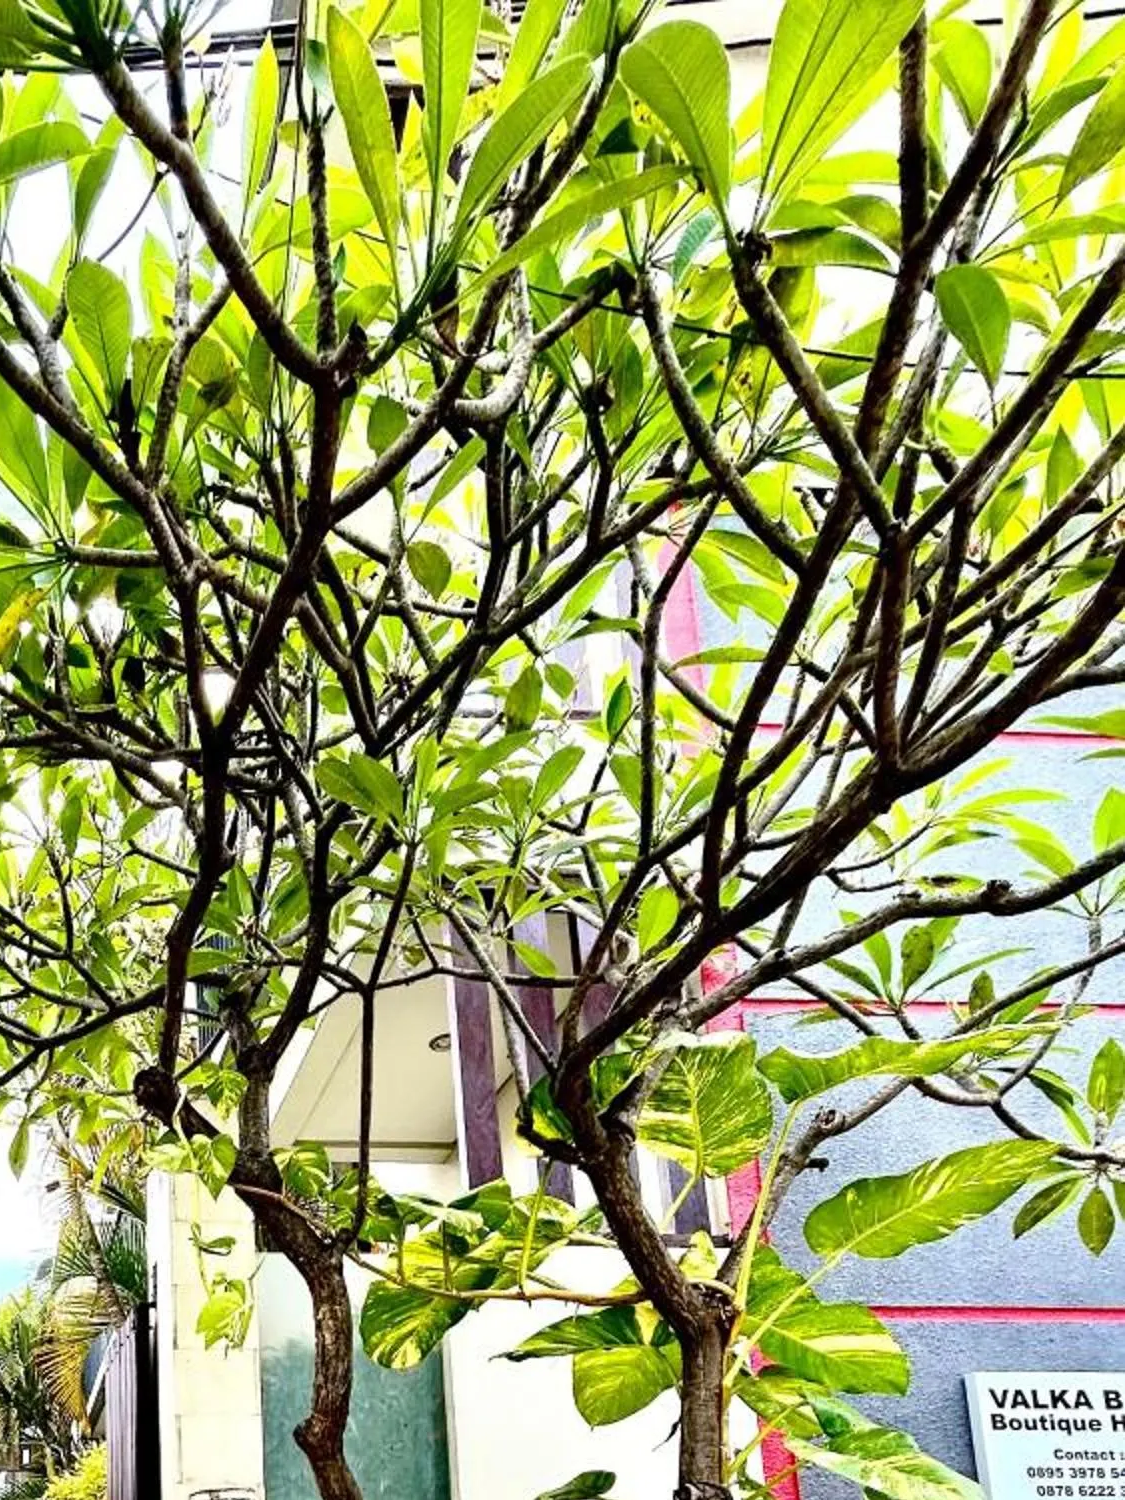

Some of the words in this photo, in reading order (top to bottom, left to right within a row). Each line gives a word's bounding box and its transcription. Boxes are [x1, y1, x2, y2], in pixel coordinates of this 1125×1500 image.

[988, 1388, 1094, 1410] VALKA
[1103, 1389, 1124, 1410] B
[990, 1413, 1102, 1436] Boutique
[1053, 1449, 1116, 1461] Contact
[1027, 1467, 1064, 1479] 0895
[1069, 1467, 1106, 1479] 3978
[1036, 1485, 1074, 1497] 0878
[1078, 1485, 1116, 1497] 6222
